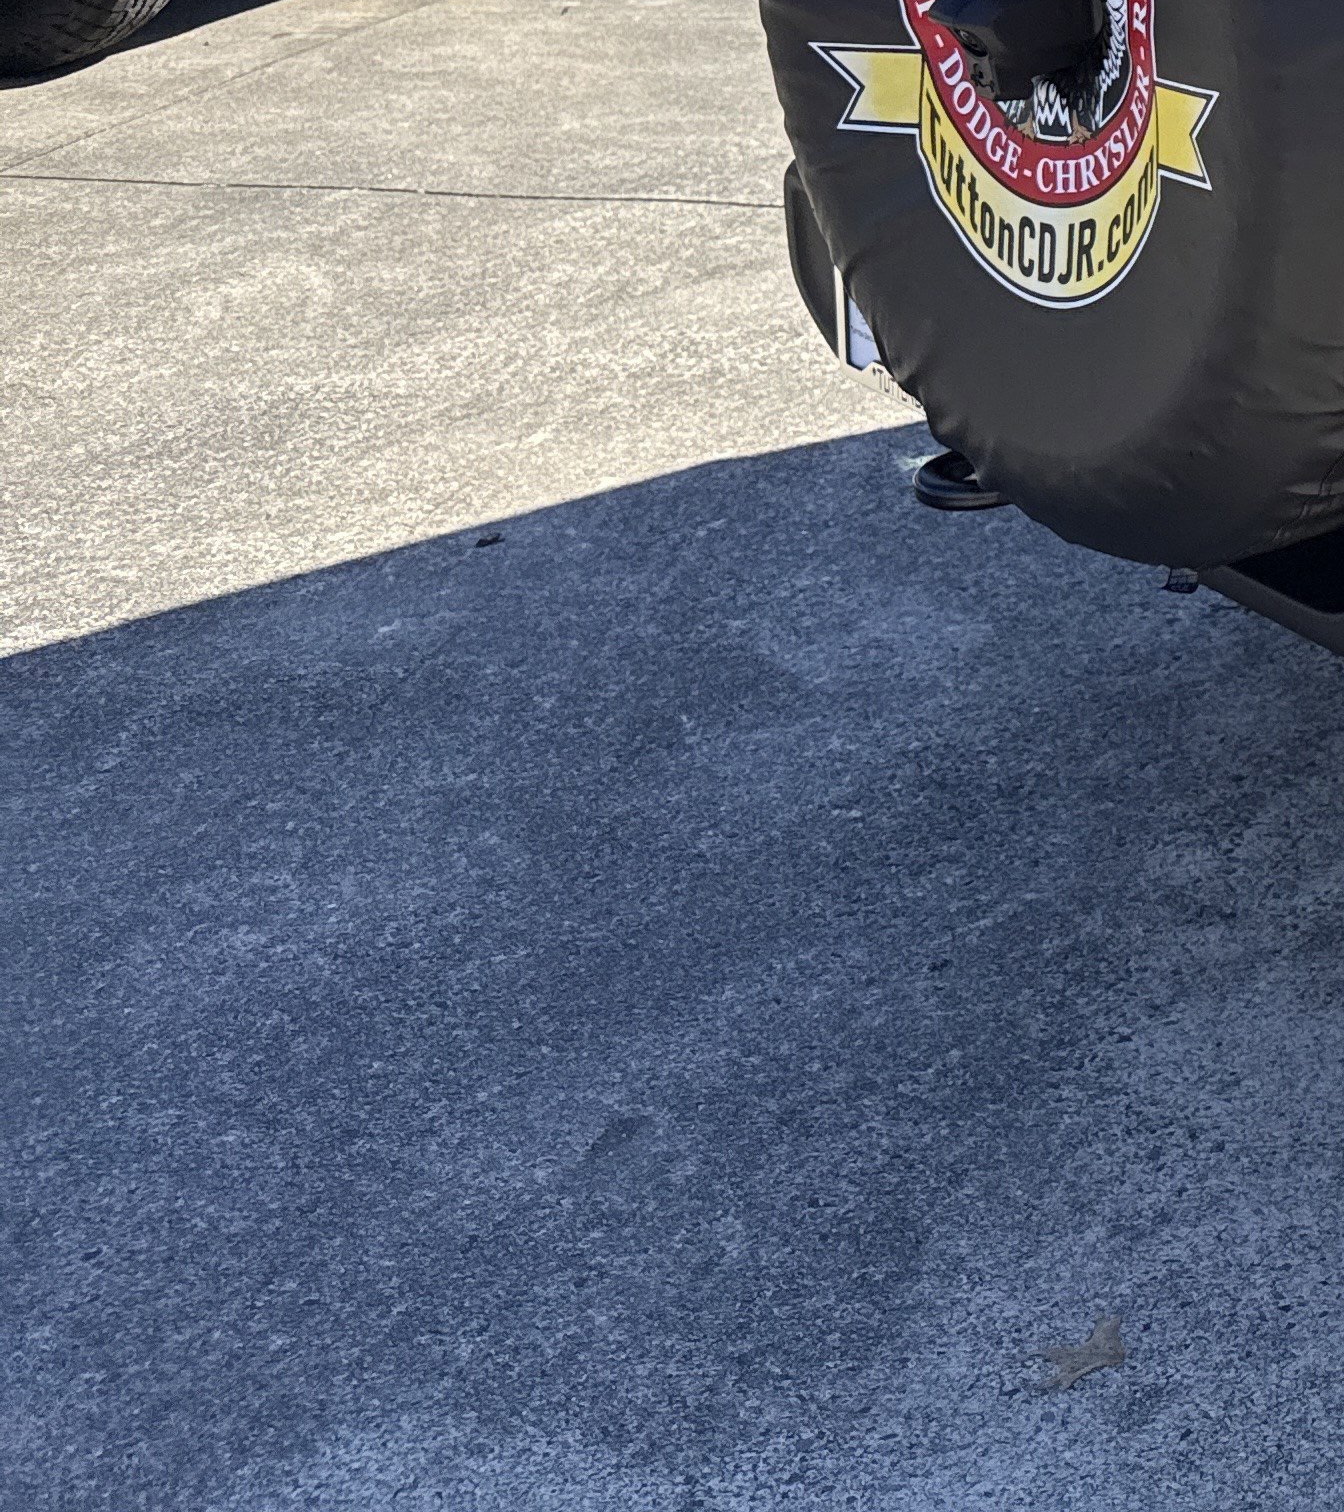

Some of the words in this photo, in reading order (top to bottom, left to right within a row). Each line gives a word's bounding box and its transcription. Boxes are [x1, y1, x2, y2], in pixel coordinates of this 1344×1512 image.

[925, 88, 1155, 285] TuttonCDJR.com
[938, 47, 1022, 179] DODGE
[1035, 64, 1151, 194] CHRYSLER
